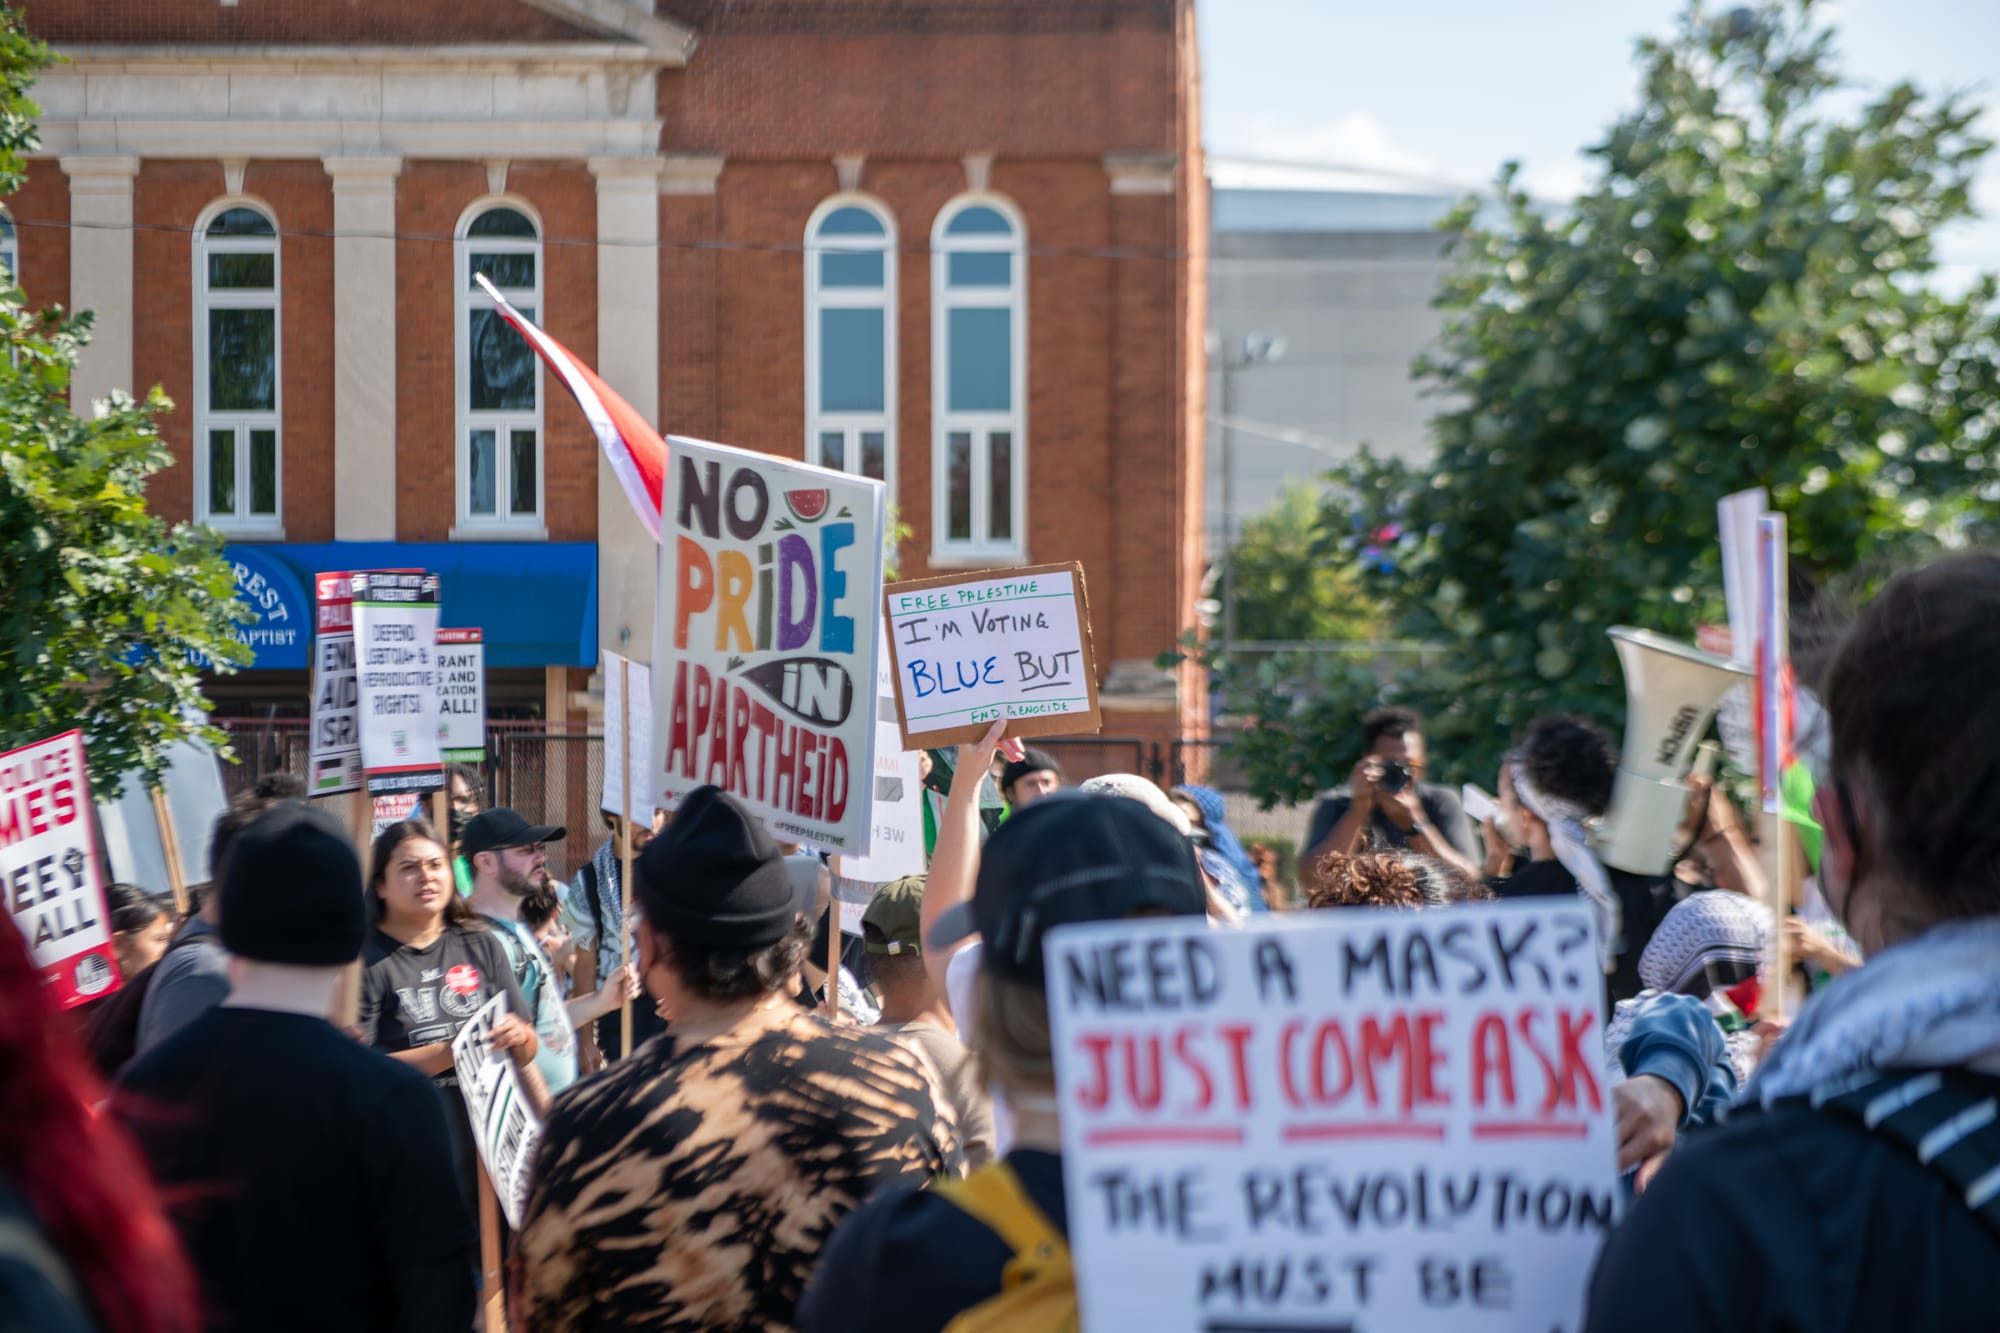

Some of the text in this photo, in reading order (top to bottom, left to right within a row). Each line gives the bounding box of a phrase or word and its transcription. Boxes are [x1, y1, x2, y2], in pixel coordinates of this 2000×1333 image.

[677, 455, 769, 541] NO
[233, 562, 289, 622] REST
[900, 581, 1039, 611] FREE PALESTINE
[898, 608, 1050, 645] I'M VOTING
[438, 655, 475, 668] RANT
[448, 671, 476, 683] AND
[907, 650, 1080, 698] BLUE BUT
[440, 699, 477, 714] ALL!
[971, 702, 1069, 725] END GENOCIDE
[0, 748, 71, 794] OLICE
[0, 779, 76, 850] MES
[10, 854, 59, 915] EE
[33, 898, 98, 949] ALL
[1064, 914, 1590, 1013] NEED A MASK?
[1076, 1006, 1603, 1119] JUST COME ASK
[1087, 1163, 1613, 1243] THE REVOLUTION
[1199, 1253, 1513, 1309] MUST BE
